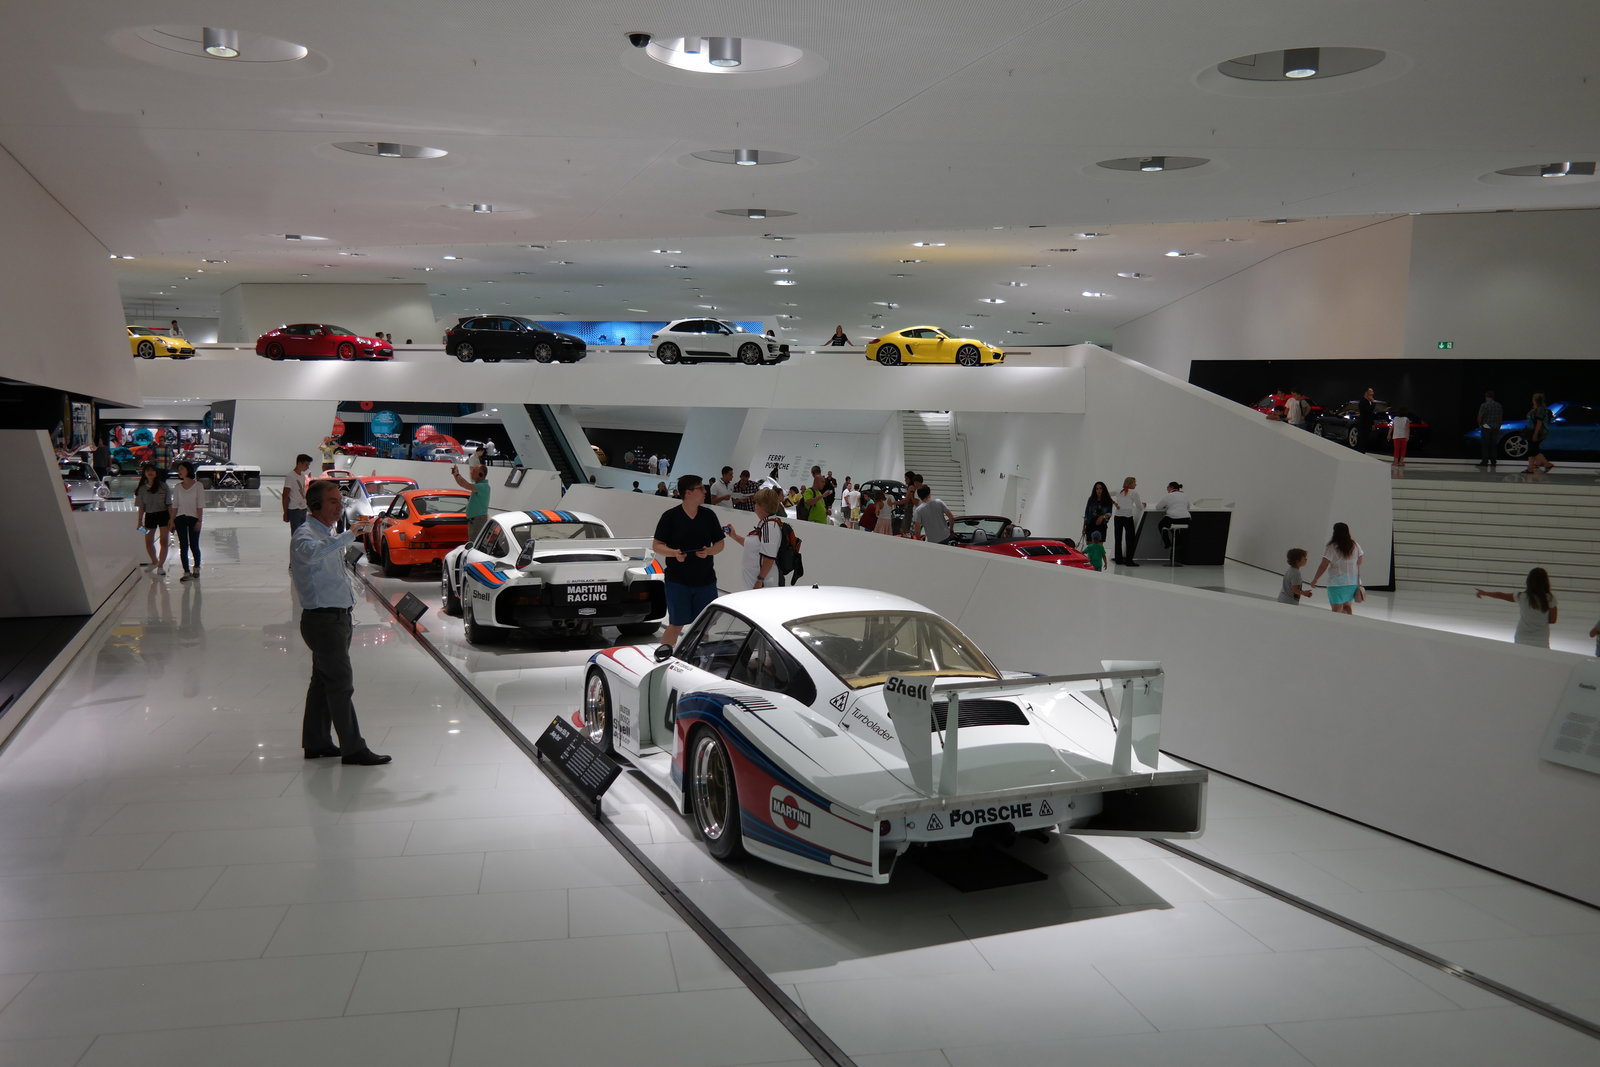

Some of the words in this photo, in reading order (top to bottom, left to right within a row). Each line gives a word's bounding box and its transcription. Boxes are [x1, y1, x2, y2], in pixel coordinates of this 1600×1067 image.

[768, 454, 785, 462] FERRY
[765, 462, 790, 470] PORCHE
[472, 589, 490, 601] Shell
[567, 585, 607, 593] MARTINI
[567, 593, 607, 602] RACING
[886, 676, 927, 701] Shell
[851, 707, 894, 741] Turbolader
[773, 799, 809, 826] MARTINI
[949, 803, 1033, 827] PORSCHE
